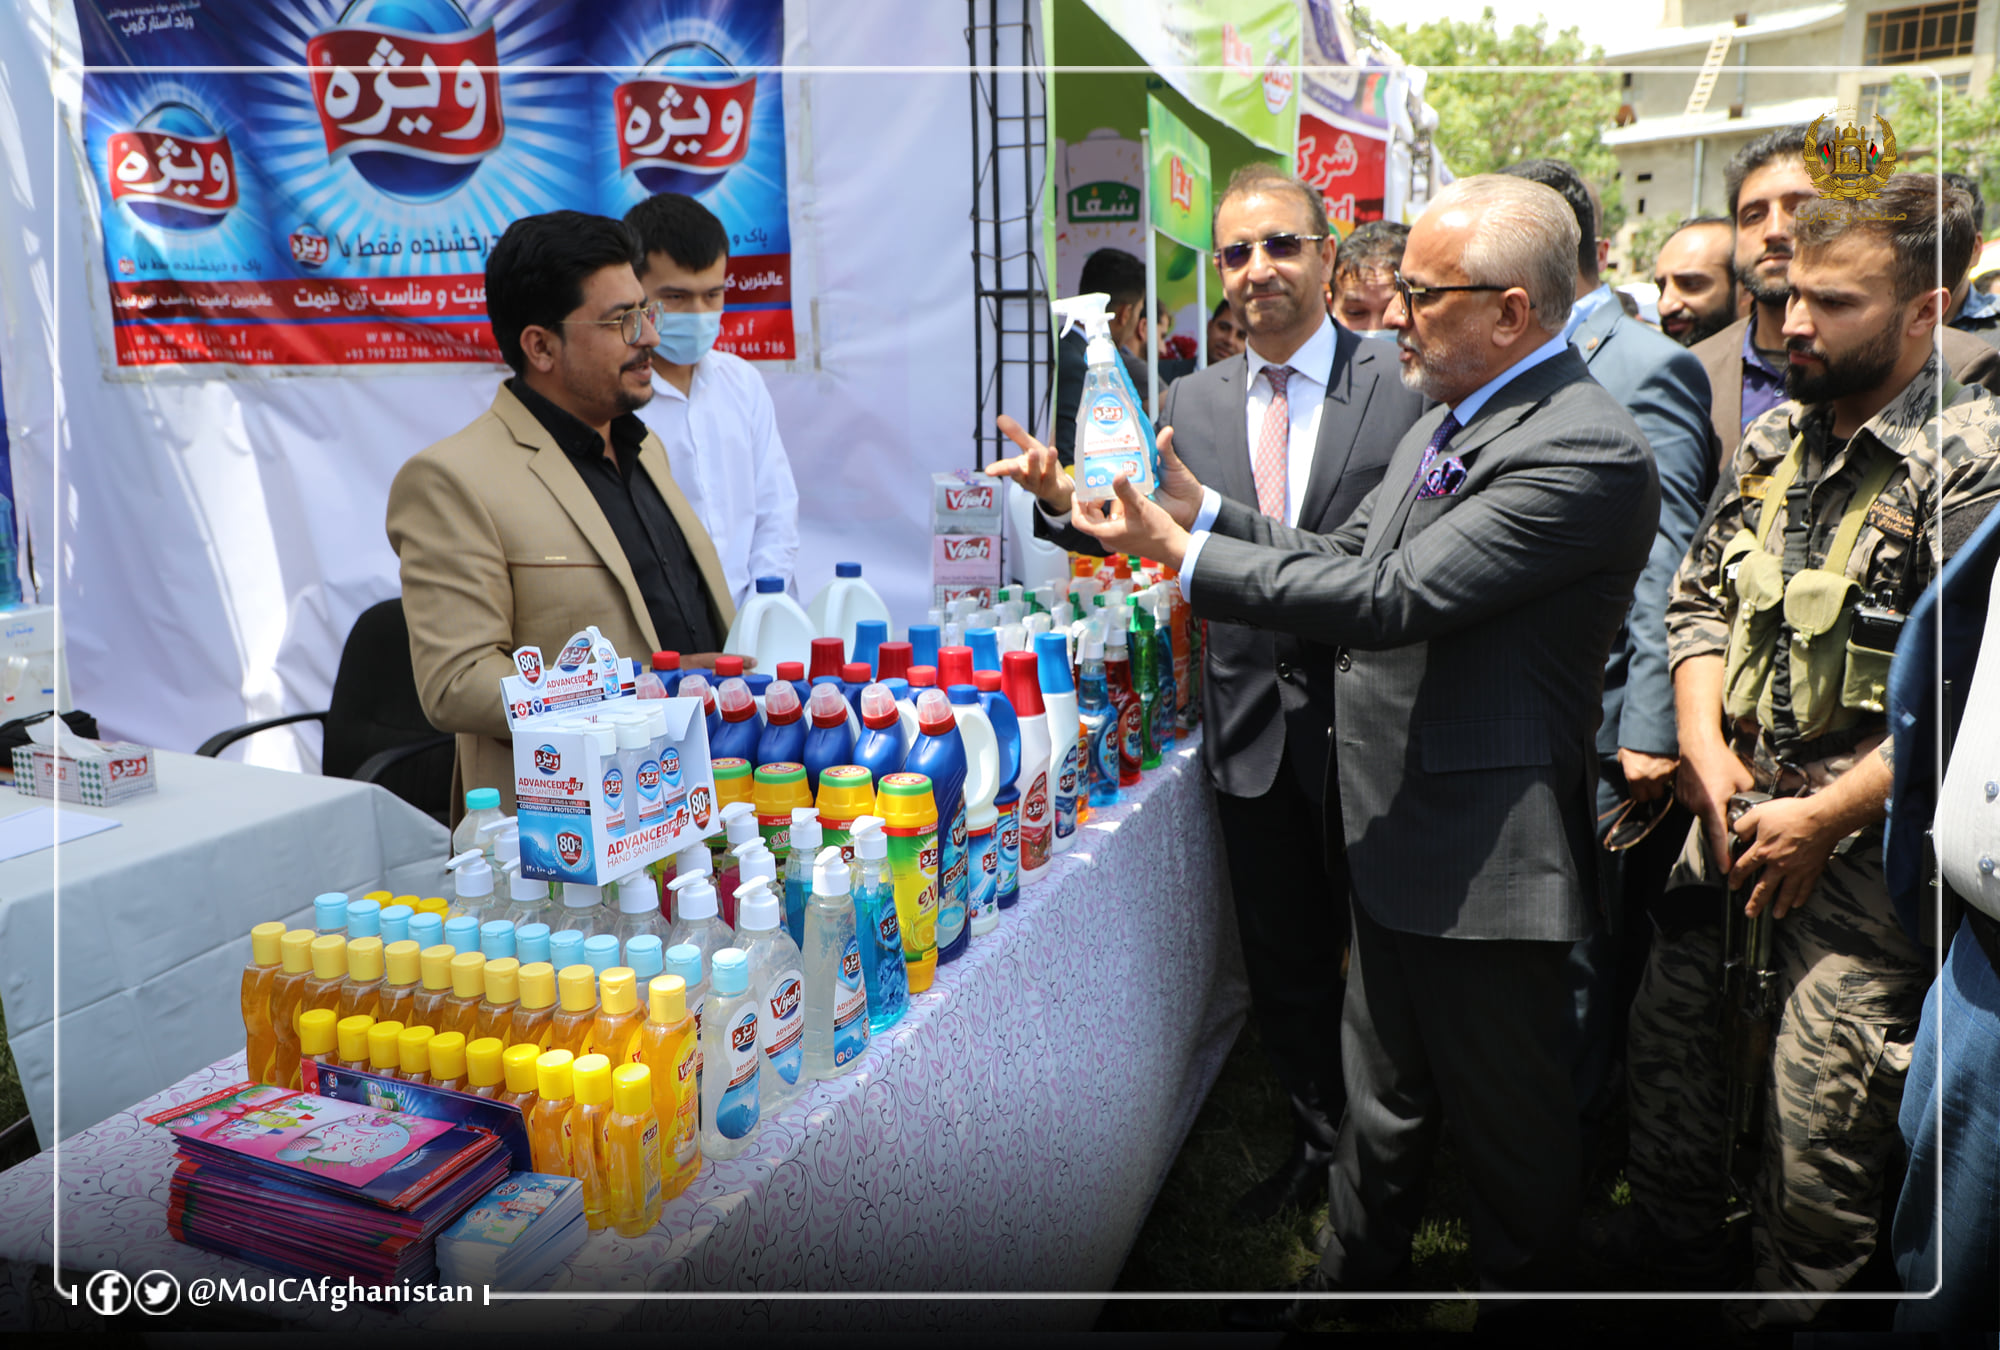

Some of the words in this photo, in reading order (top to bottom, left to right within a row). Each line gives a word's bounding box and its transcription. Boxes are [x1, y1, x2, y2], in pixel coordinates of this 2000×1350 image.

[324, 37, 487, 140] ویژه
[624, 85, 744, 157] ویژه
[116, 137, 230, 201] ویژه
[291, 234, 329, 262] ویژه
[336, 233, 351, 264] با
[357, 232, 403, 257] فقط
[743, 228, 768, 249] پاک
[738, 270, 784, 291] عالیترین
[293, 287, 341, 313] قیمت
[343, 284, 369, 311] ترین
[370, 281, 432, 312] مناسب
[435, 289, 447, 310] و
[947, 487, 991, 510] Vijeh
[946, 539, 989, 561] Vijeh
[561, 646, 587, 664] ویژه
[113, 756, 148, 776] ویژه
[535, 752, 560, 768] ویژه
[518, 777, 564, 789] ADVANCED
[607, 824, 671, 858] ADVANCED
[669, 814, 689, 834] PLUS
[607, 850, 632, 869] HAND
[633, 835, 668, 859] SANITIZER
[772, 984, 801, 1016] Vijeh
